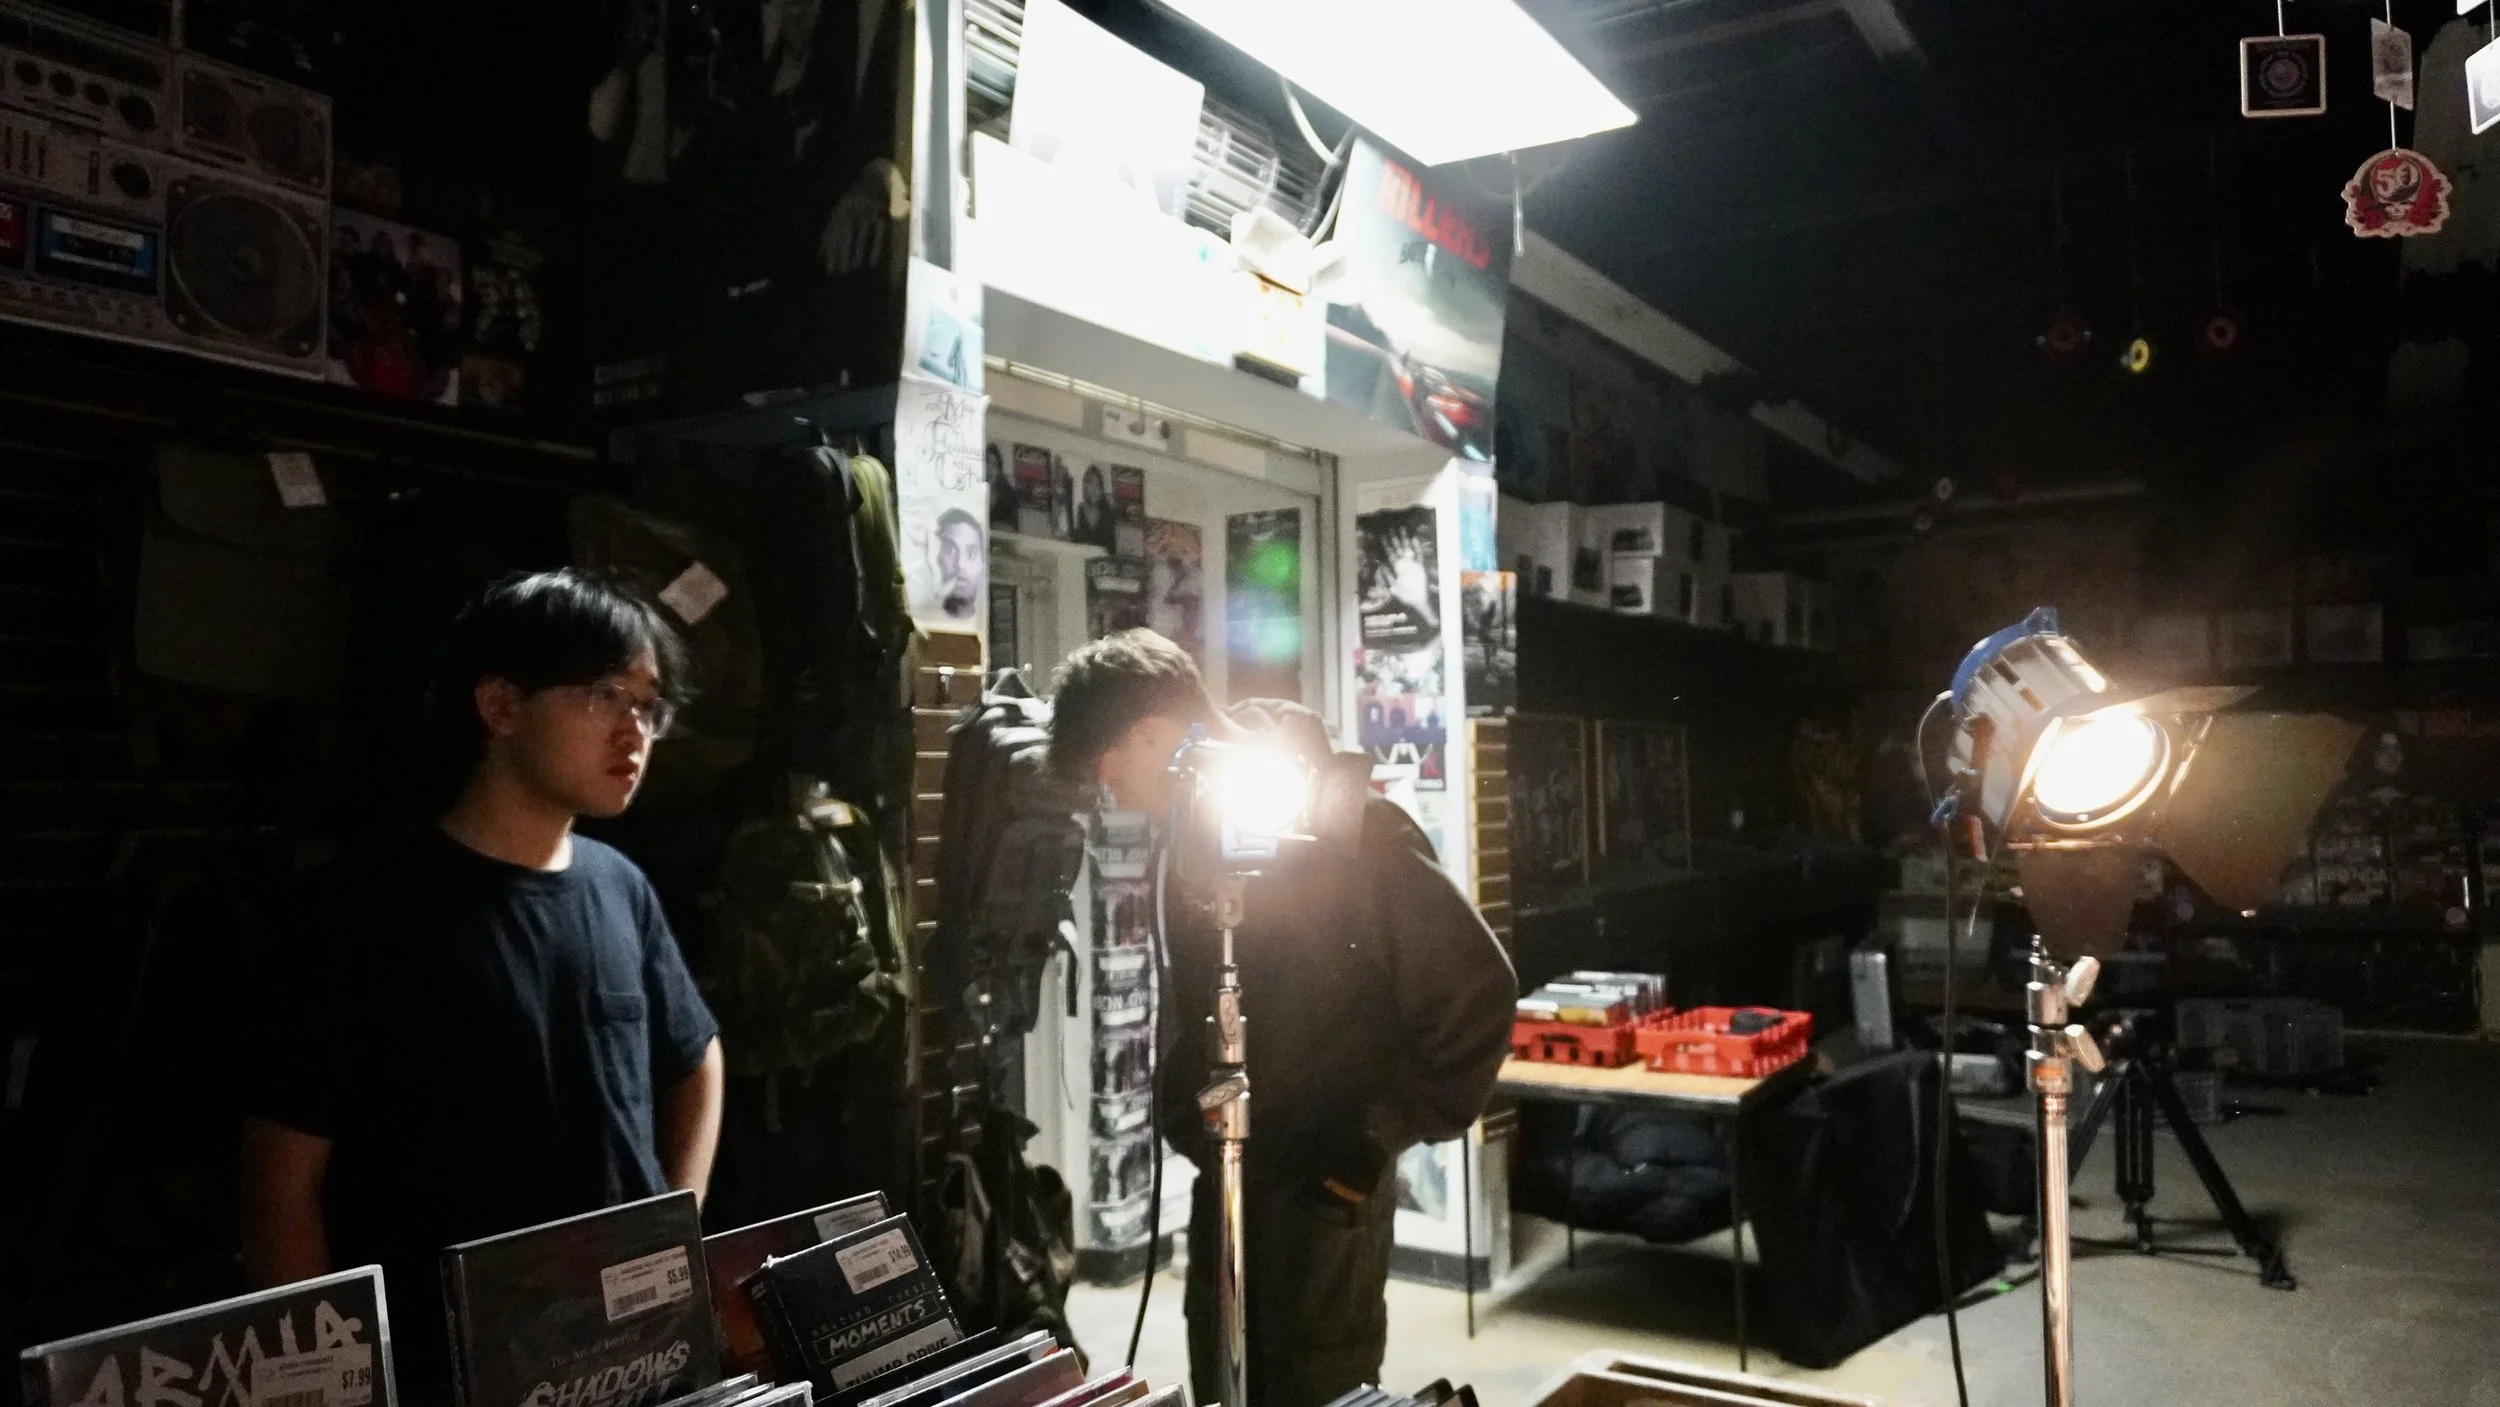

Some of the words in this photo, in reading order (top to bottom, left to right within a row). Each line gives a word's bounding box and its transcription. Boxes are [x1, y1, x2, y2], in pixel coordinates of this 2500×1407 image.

[829, 1299, 926, 1356] MOMENTS
[342, 1366, 371, 1389] $7.99
[518, 1340, 691, 1407] SHADOWS
